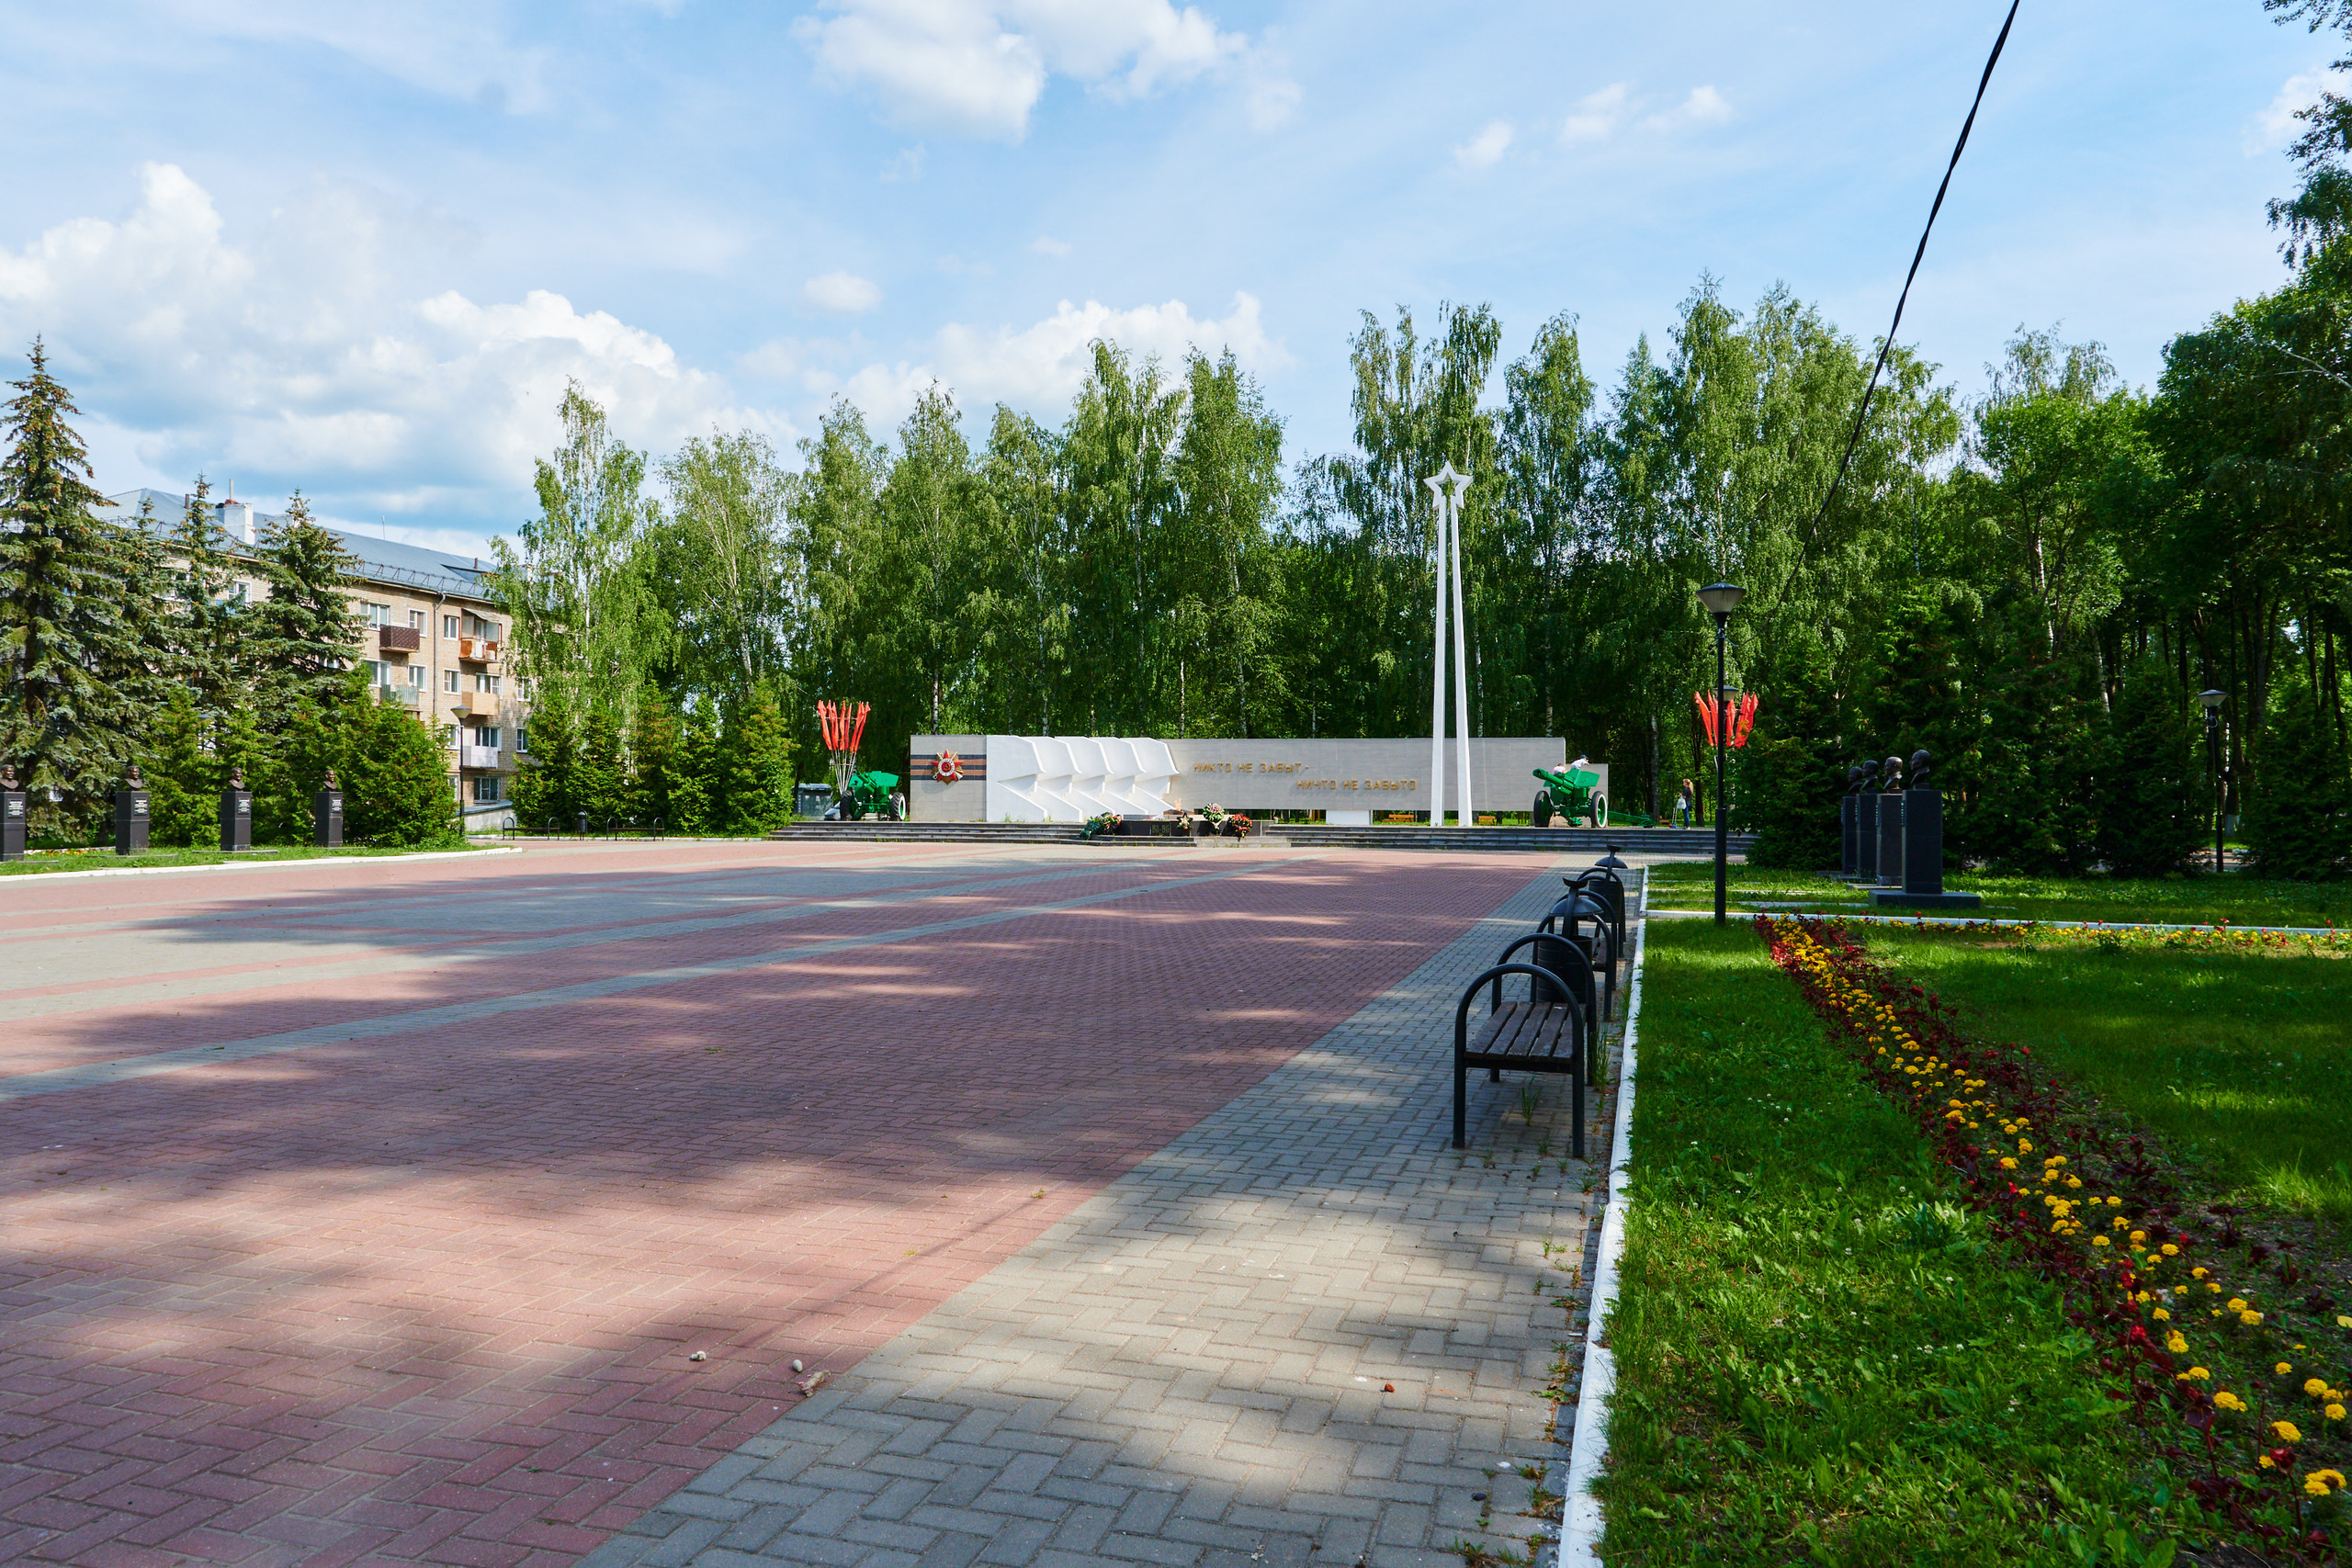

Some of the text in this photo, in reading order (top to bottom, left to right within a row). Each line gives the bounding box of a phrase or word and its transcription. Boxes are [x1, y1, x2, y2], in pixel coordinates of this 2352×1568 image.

[1193, 761, 1232, 773] НИКТО
[1238, 762, 1253, 773] НЕ
[1260, 762, 1301, 773] ЗАБЫТ
[1296, 780, 1417, 790] НИЧТО НЕ ЗАБЫТО
